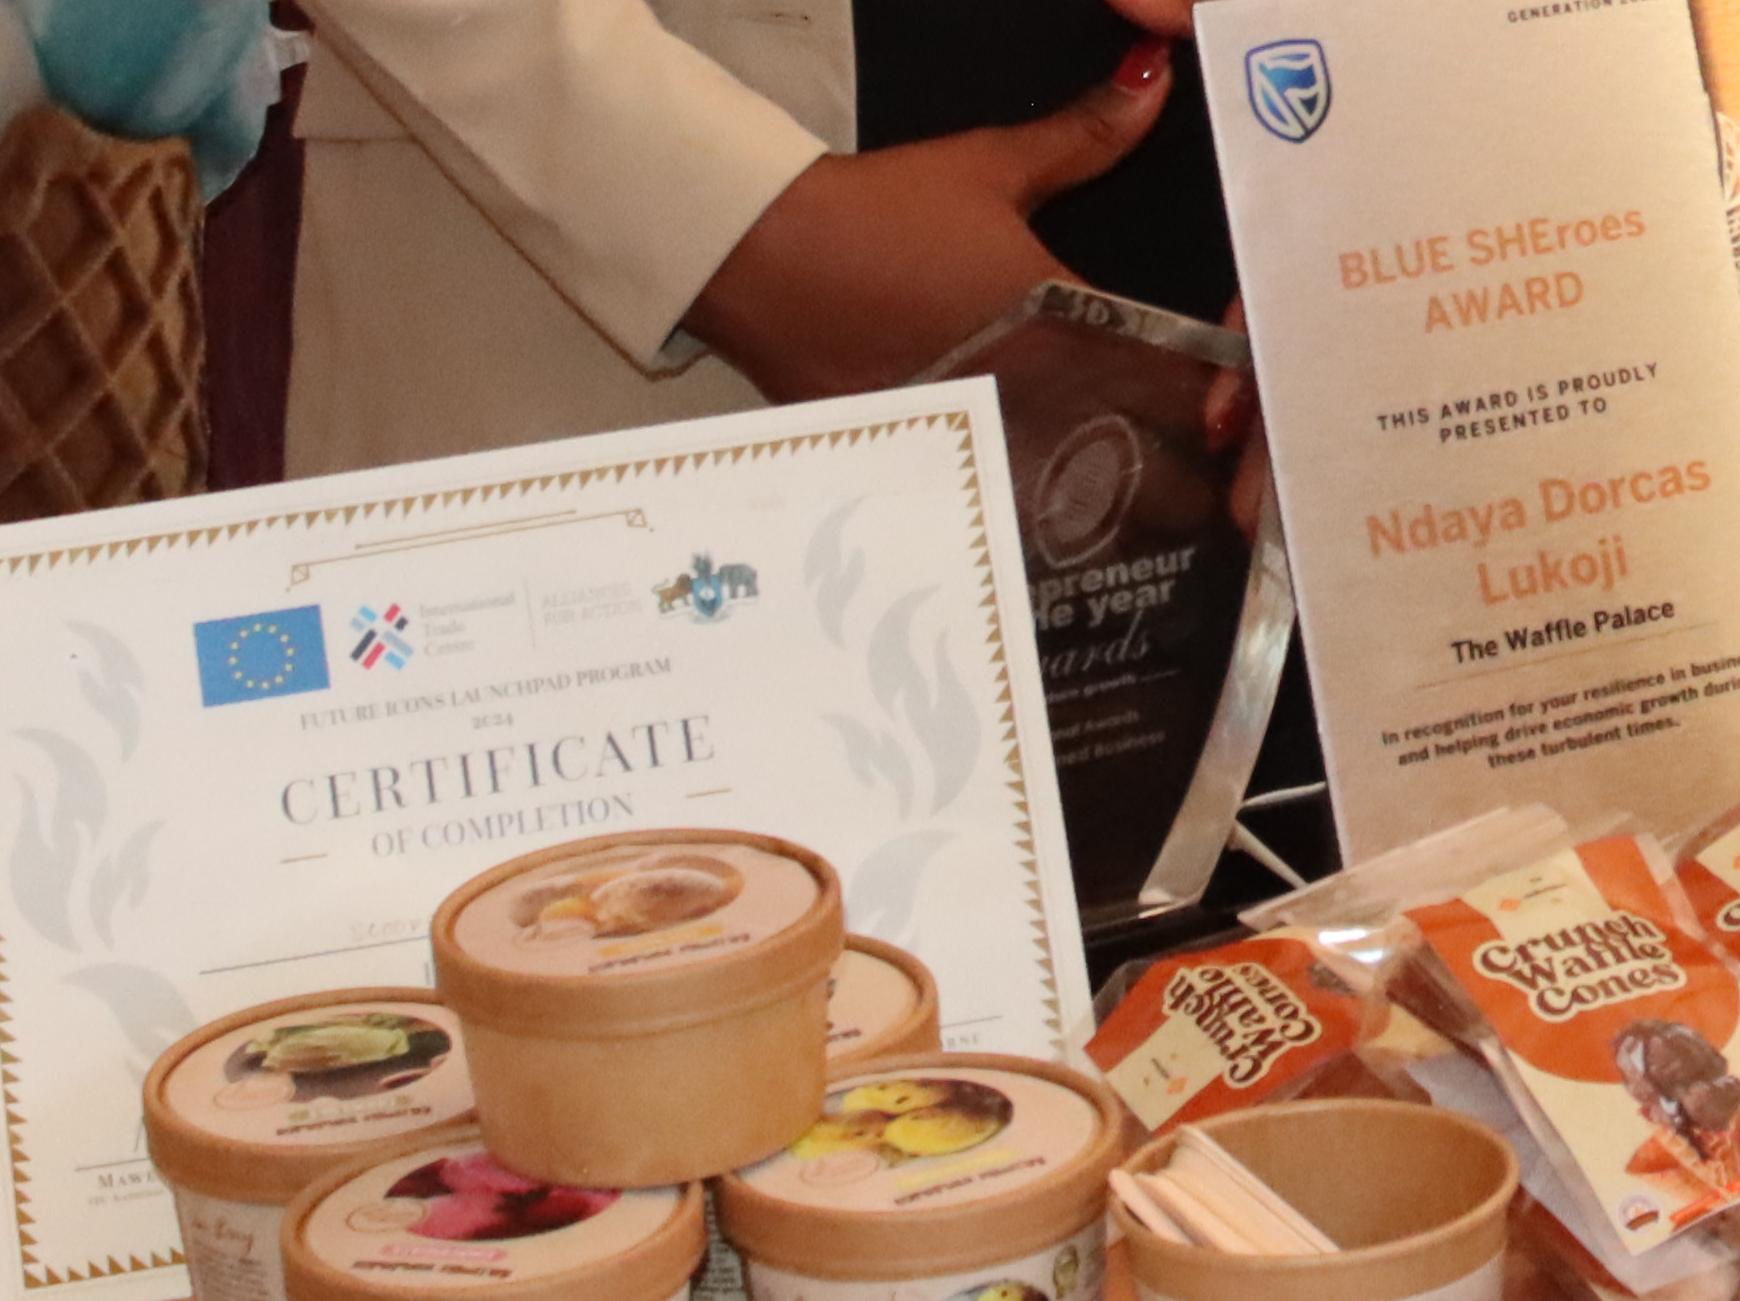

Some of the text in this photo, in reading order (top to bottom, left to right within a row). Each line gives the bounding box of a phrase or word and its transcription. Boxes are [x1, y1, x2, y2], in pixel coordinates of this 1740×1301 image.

[1338, 209, 1647, 291] BLUE SHEroes
[1424, 270, 1585, 334] AWARD
[1376, 362, 1658, 431] THIS AWARD IS PROUDLY
[1439, 396, 1607, 443] PRESENTED TO
[1365, 459, 1712, 558] Ndaya Dorcas
[1031, 547, 1197, 602] preneur
[1476, 533, 1628, 605] Lukoji
[1087, 579, 1177, 629] year
[1450, 600, 1676, 664] The Waffle Palace
[299, 656, 673, 731] FUTURE ICONS LAUNCHPAD PROGRAM
[1381, 730, 1400, 746] In
[1403, 707, 1505, 742] recognition
[1509, 701, 1535, 718] for
[1539, 694, 1577, 715] your
[1582, 672, 1666, 701] resilience
[1669, 666, 1687, 682] in
[1397, 746, 1430, 767] and
[1434, 730, 1500, 759] helping
[1504, 721, 1548, 742] drive
[1553, 702, 1635, 732] economic
[1639, 686, 1700, 715] growth
[279, 713, 717, 827] CERTIFICATE
[1487, 713, 1682, 769] these turbulent times.
[370, 792, 636, 860] OF COMPLETION
